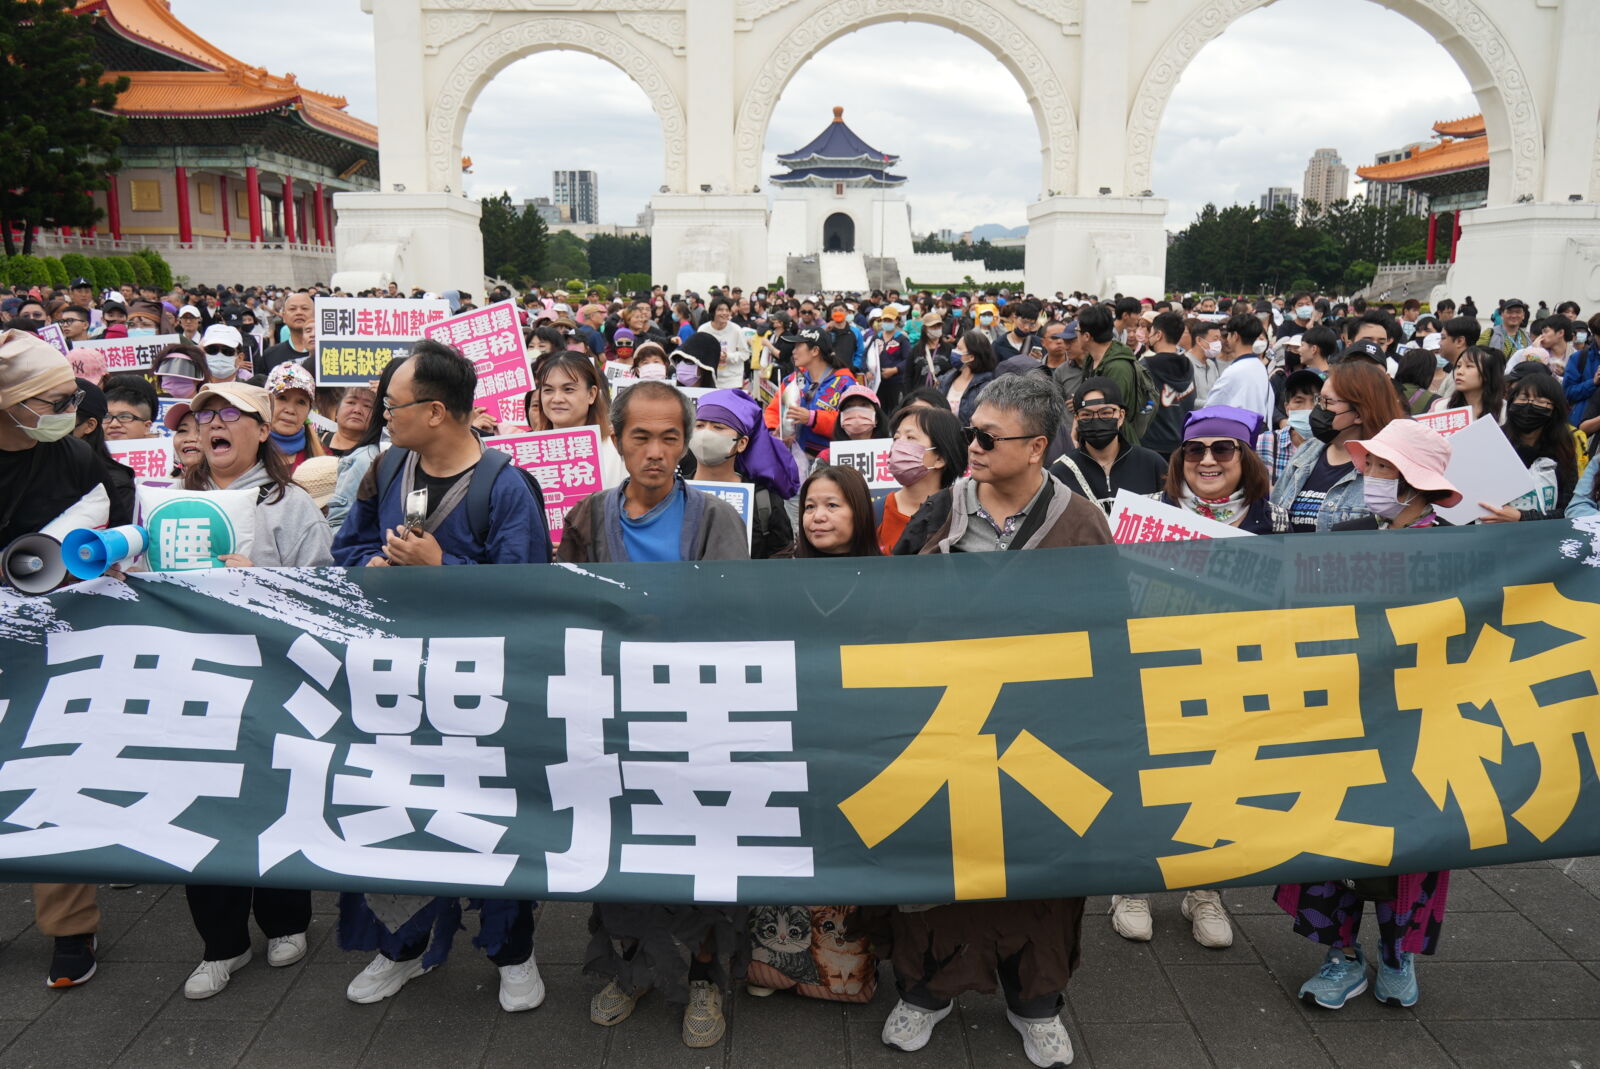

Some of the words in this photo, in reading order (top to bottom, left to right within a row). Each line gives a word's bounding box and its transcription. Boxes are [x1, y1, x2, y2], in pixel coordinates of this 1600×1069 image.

[429, 308, 513, 346] 我要選擇
[94, 343, 171, 367] 菸捐在那
[461, 331, 518, 362] 要稅
[159, 518, 212, 569] 睡
[0, 582, 1600, 902] 要選擇不要稅
